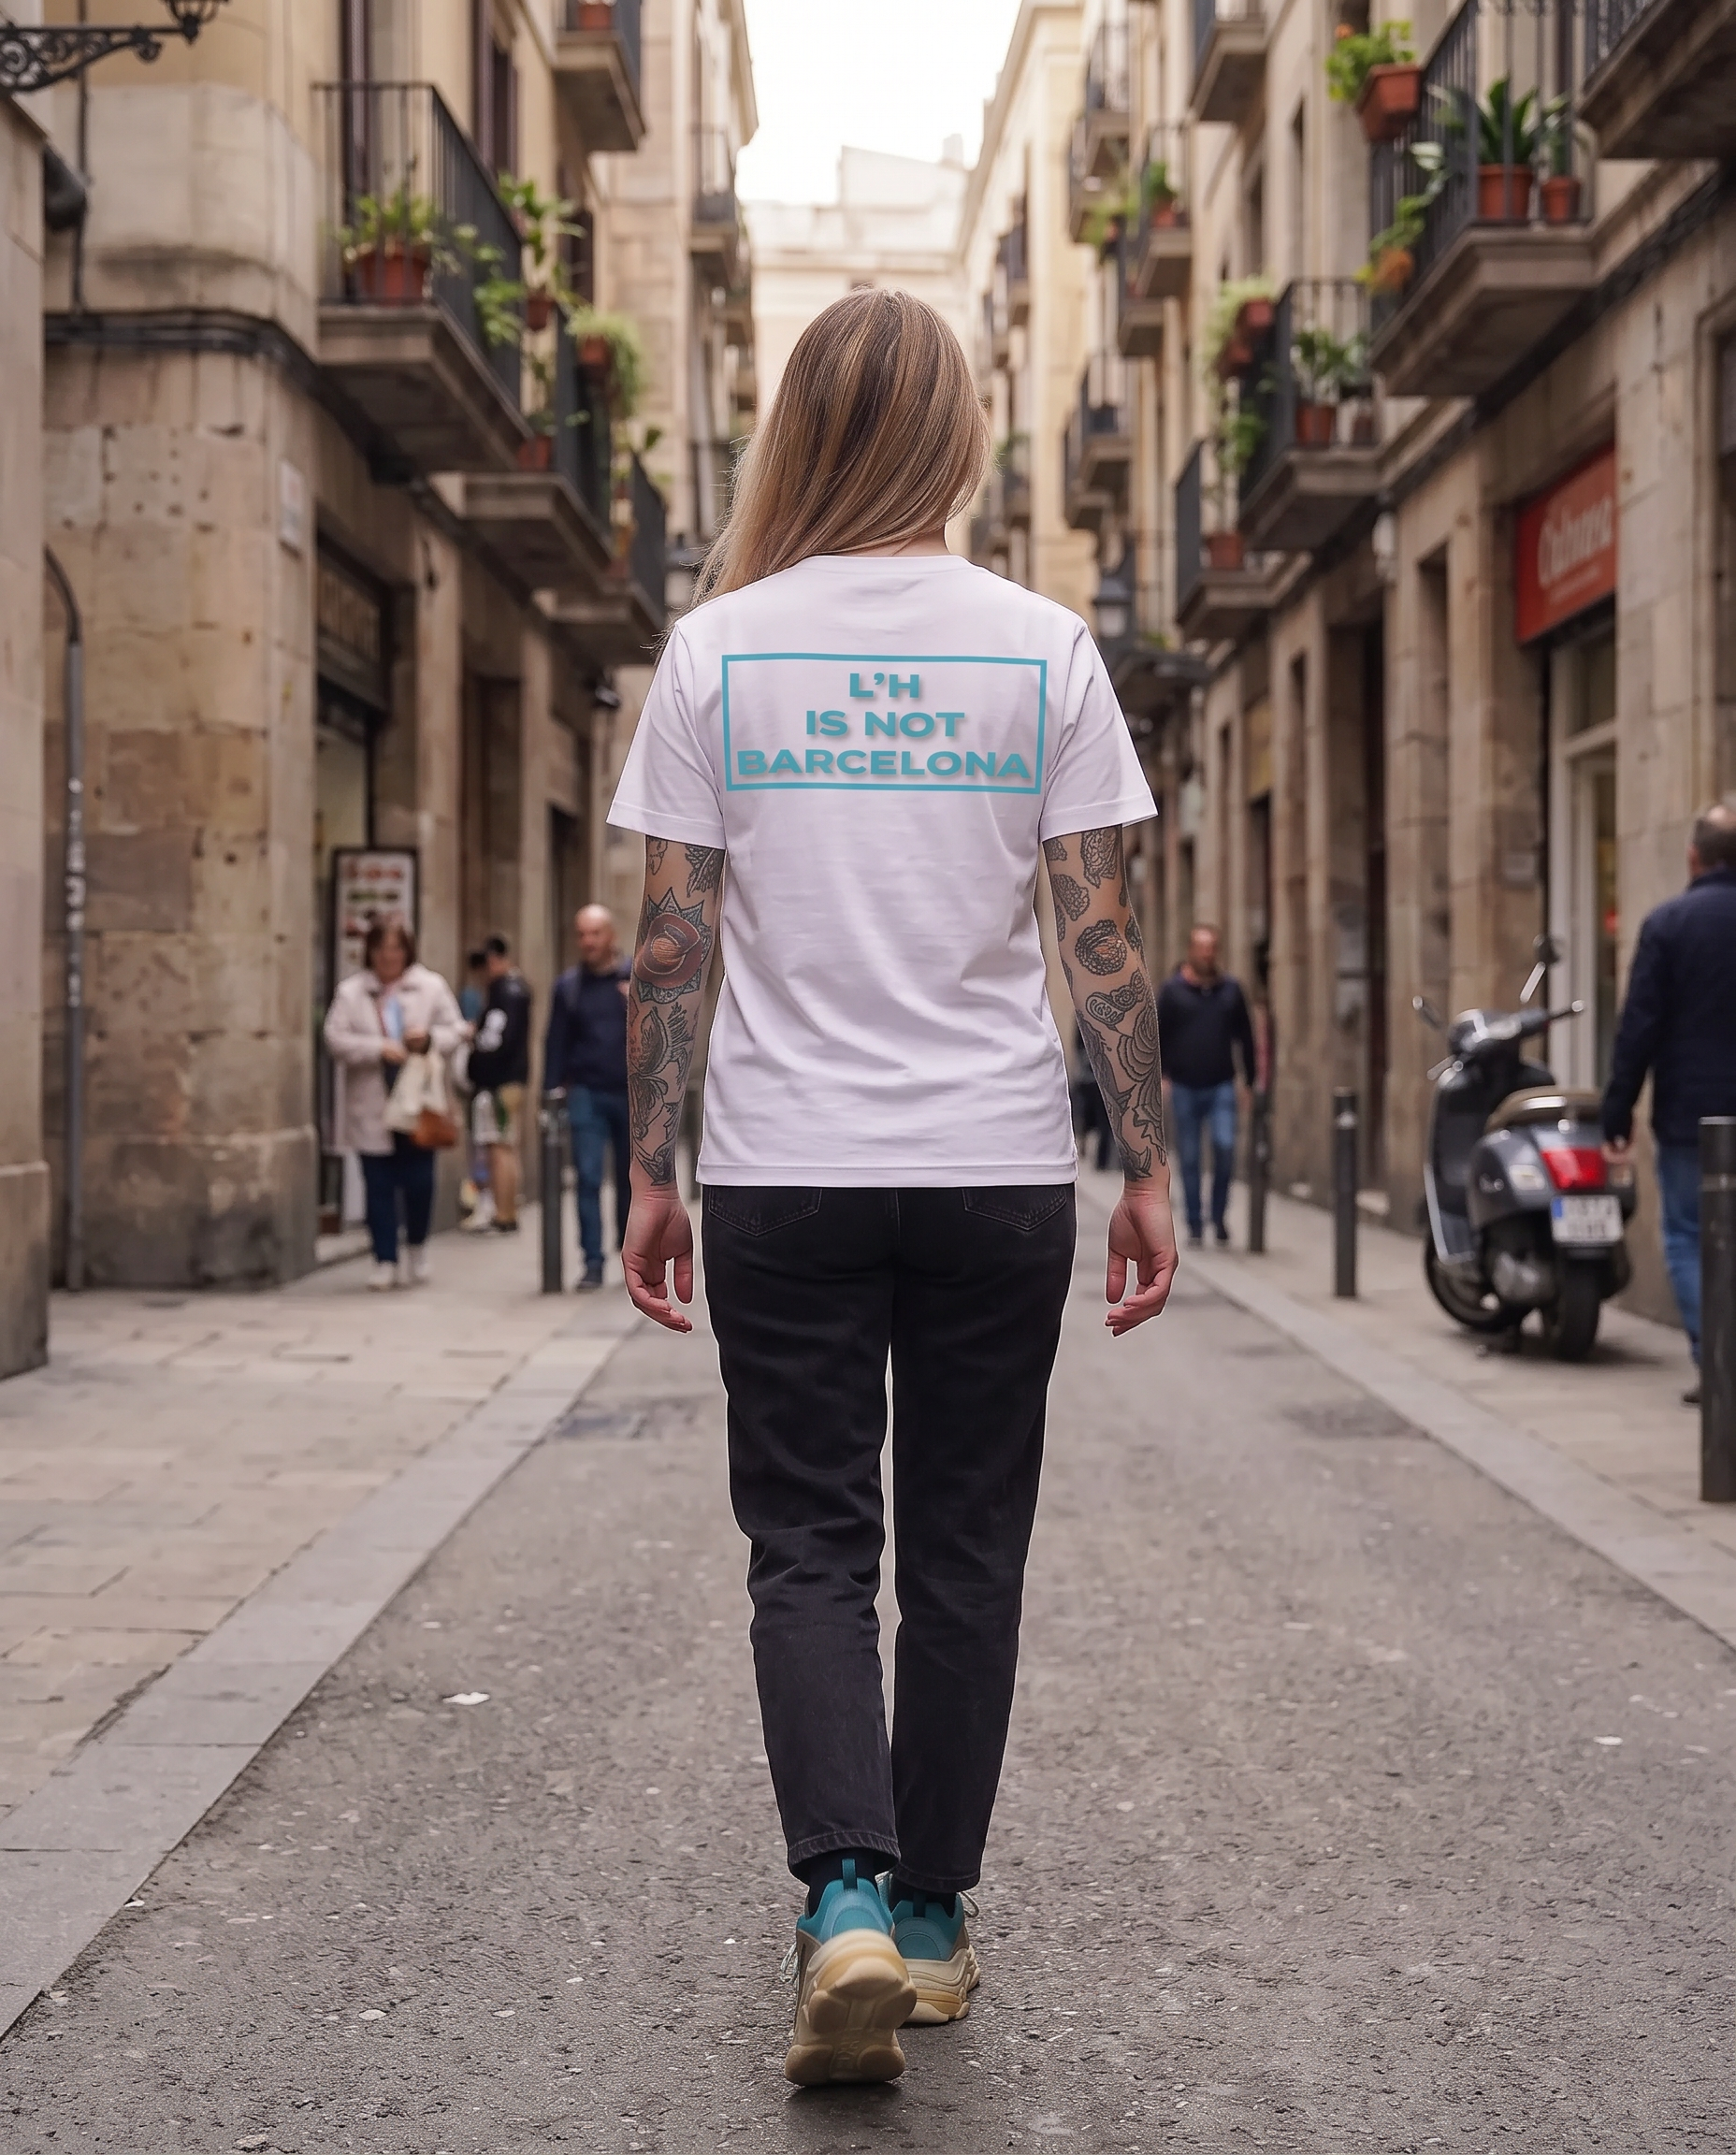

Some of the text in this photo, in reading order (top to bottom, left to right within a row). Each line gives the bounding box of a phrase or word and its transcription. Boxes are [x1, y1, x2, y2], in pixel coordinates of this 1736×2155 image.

[806, 710, 965, 738] IS NOT
[737, 749, 1031, 779] BARCELONA
